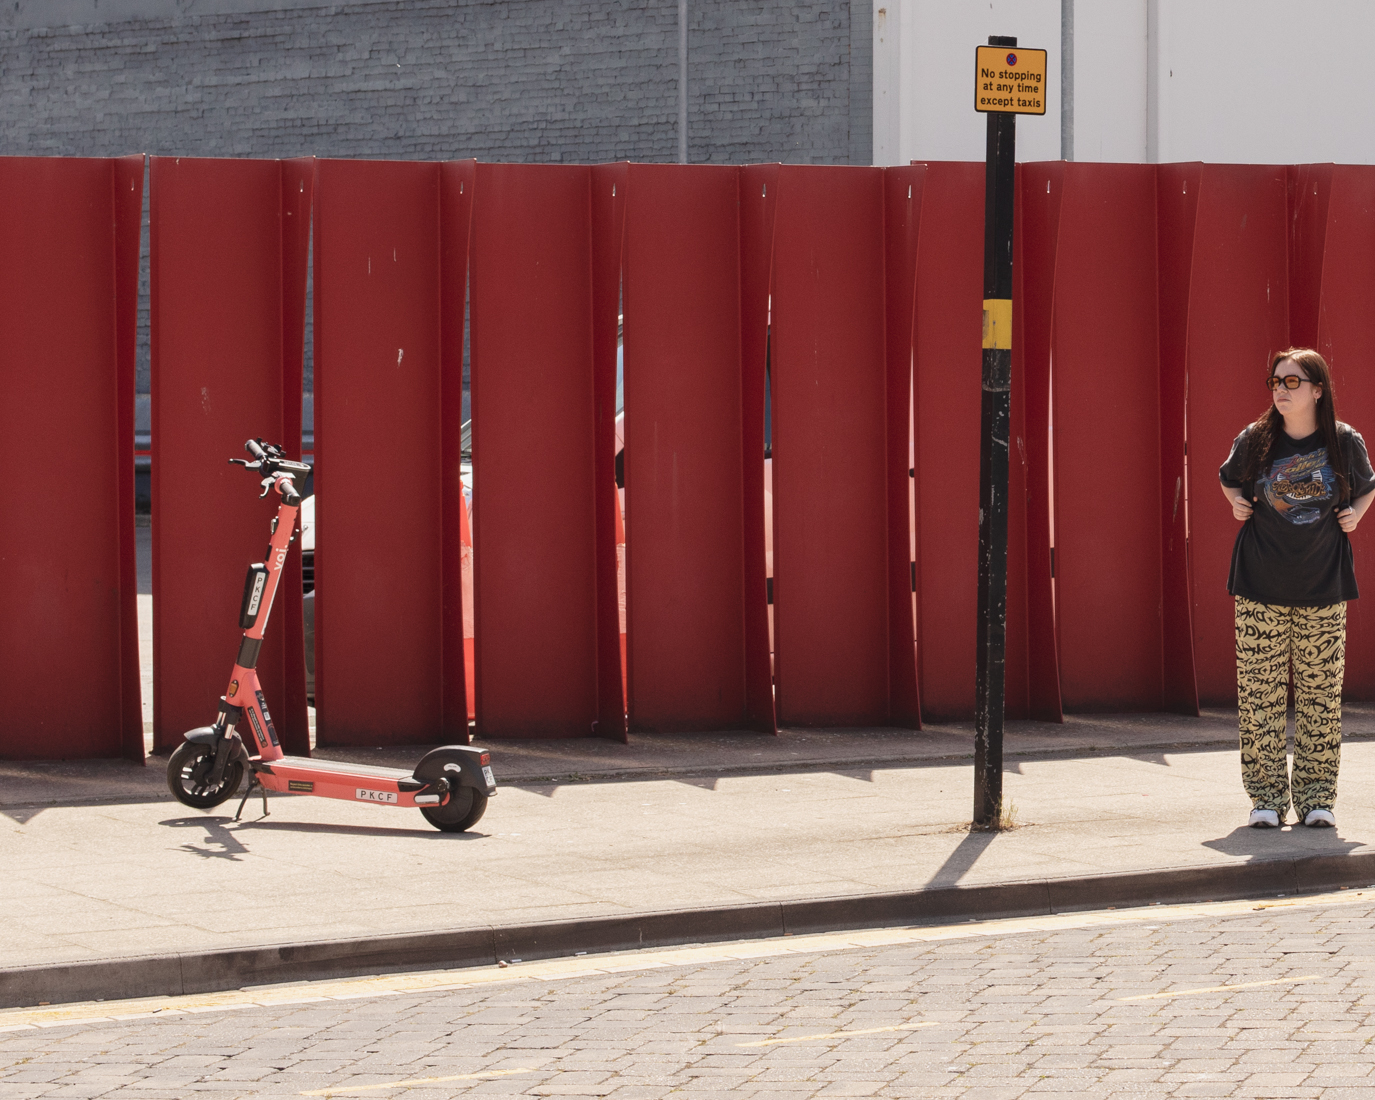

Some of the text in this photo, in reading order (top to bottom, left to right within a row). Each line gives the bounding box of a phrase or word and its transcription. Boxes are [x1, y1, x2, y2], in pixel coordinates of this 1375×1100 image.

[981, 68, 1042, 83] No stopping
[983, 81, 1039, 93] at any time
[980, 96, 1041, 108] except taxis
[250, 577, 263, 611] PKCF
[360, 790, 393, 802] PKCF
